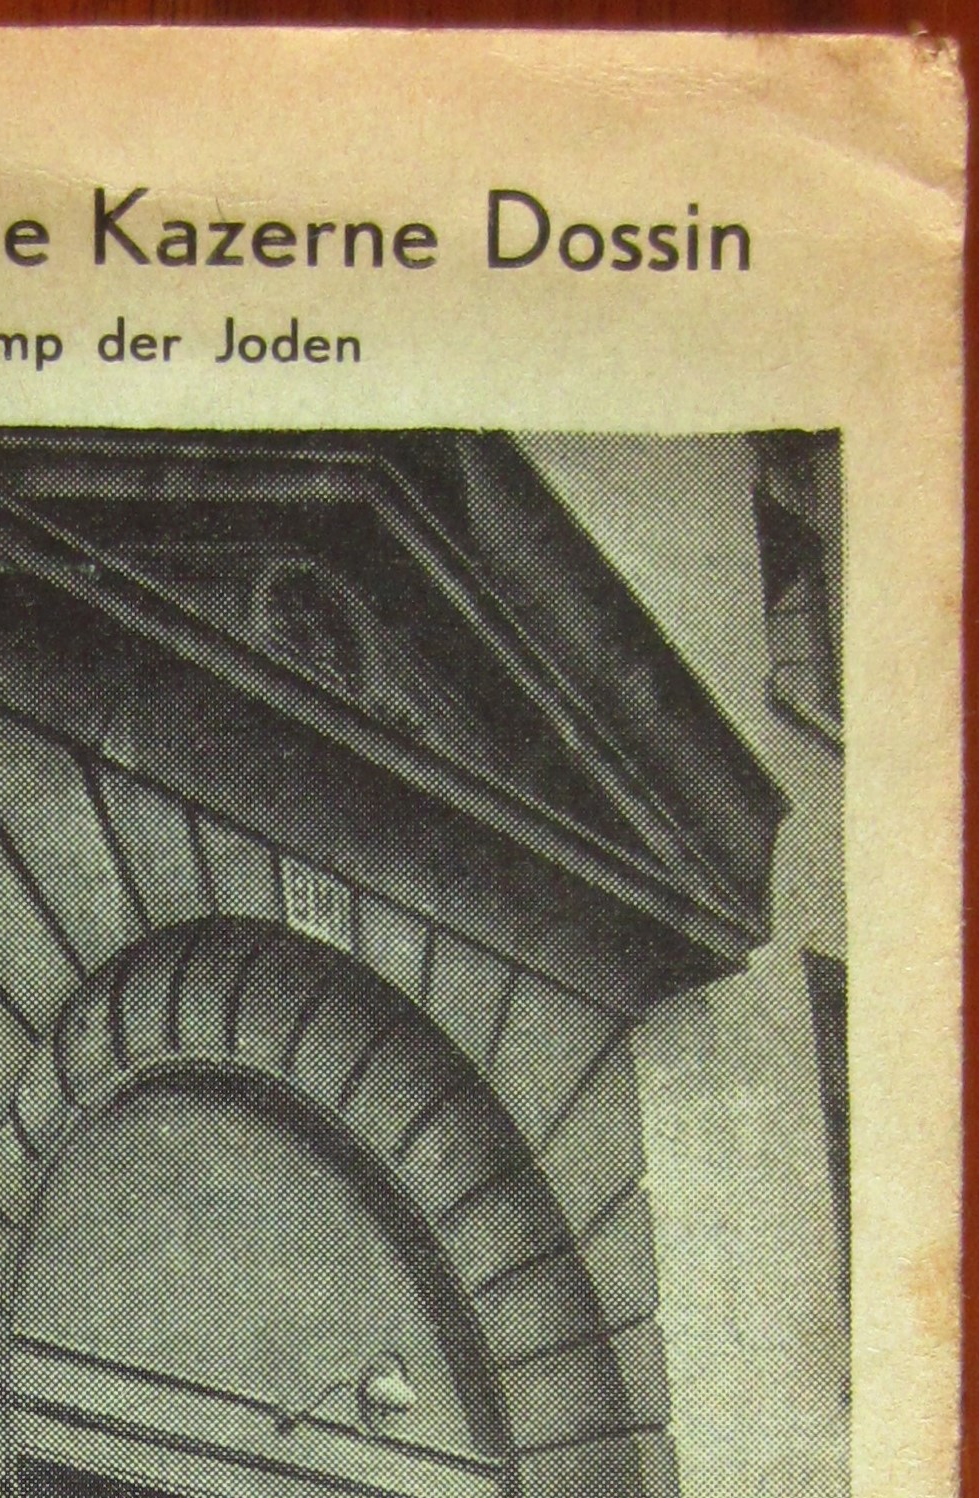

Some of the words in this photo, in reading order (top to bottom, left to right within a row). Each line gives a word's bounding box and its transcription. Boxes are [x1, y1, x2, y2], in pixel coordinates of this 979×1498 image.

[94, 187, 438, 269] Kazerne
[487, 189, 751, 272] Dossin
[98, 316, 182, 362] der
[216, 317, 361, 363] Joden
